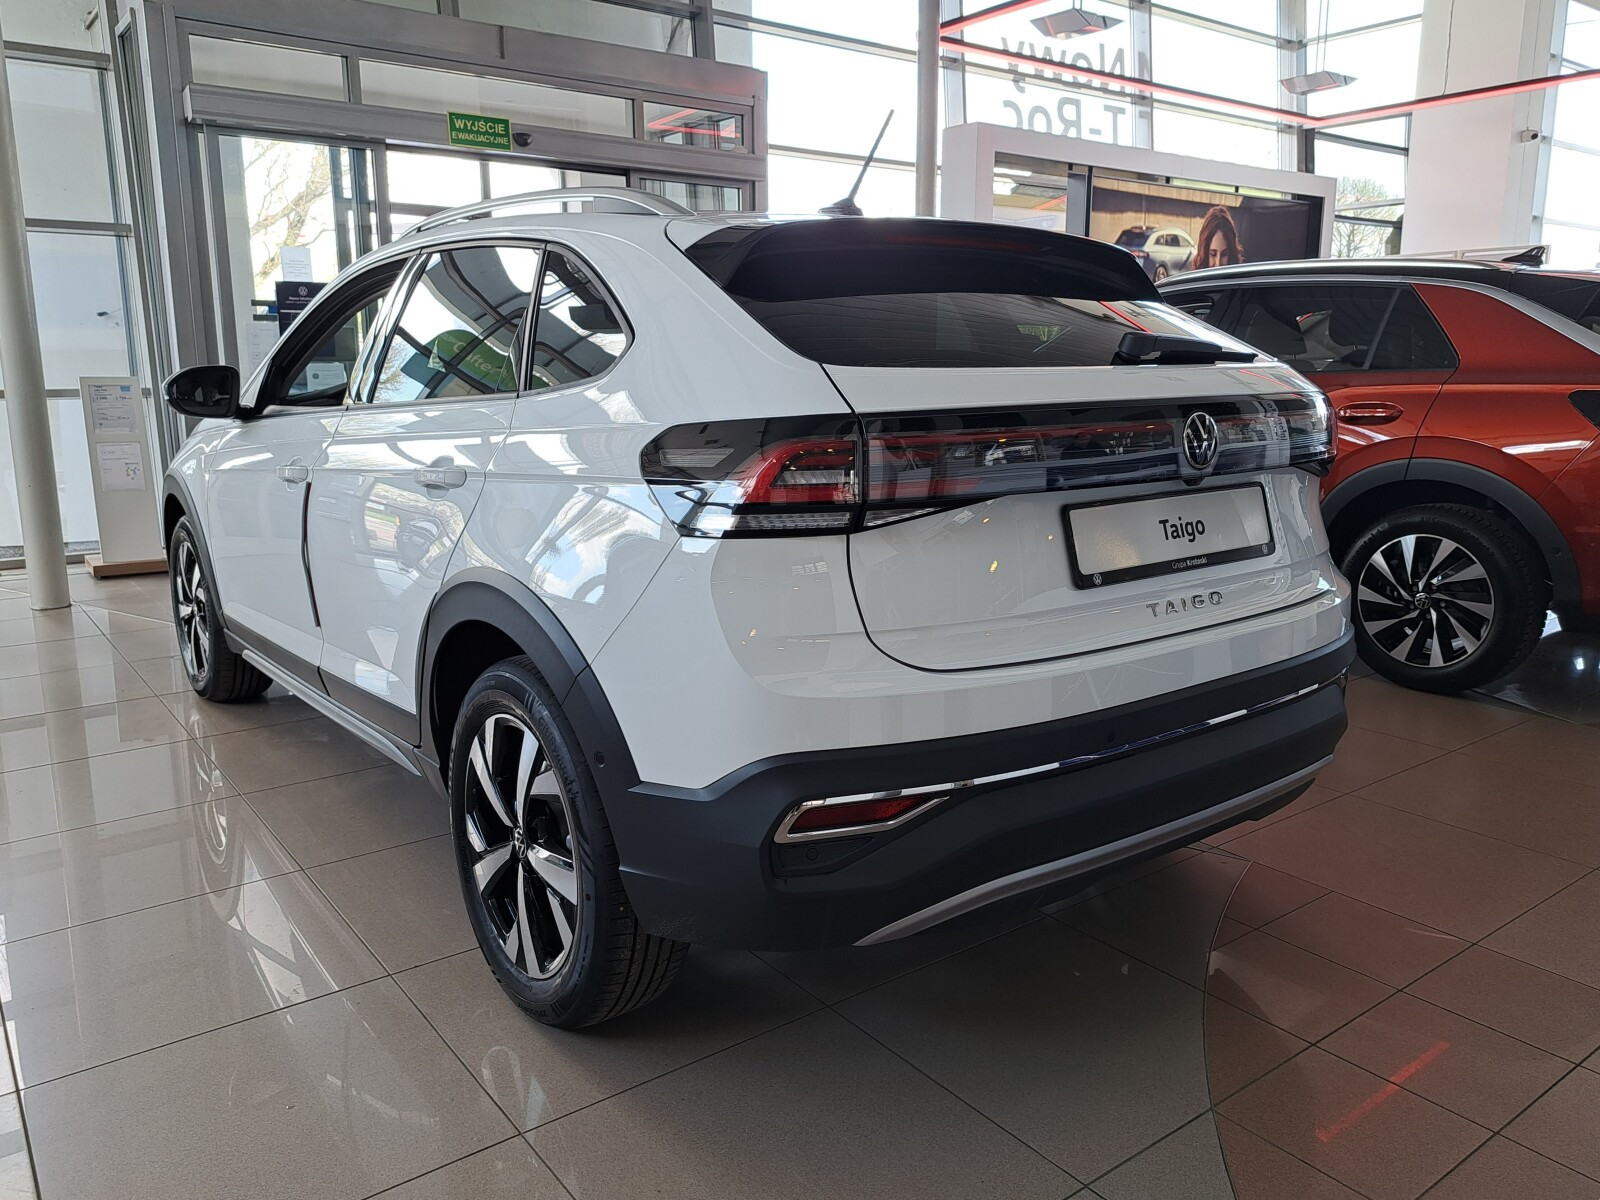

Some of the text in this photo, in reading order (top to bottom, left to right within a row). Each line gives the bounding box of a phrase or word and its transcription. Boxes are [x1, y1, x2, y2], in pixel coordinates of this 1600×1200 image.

[454, 118, 506, 134] WYJŚCIE
[452, 131, 510, 145] EWAKUACYJNE
[1158, 516, 1206, 542] Taigo
[1146, 591, 1224, 618] TAIGO
